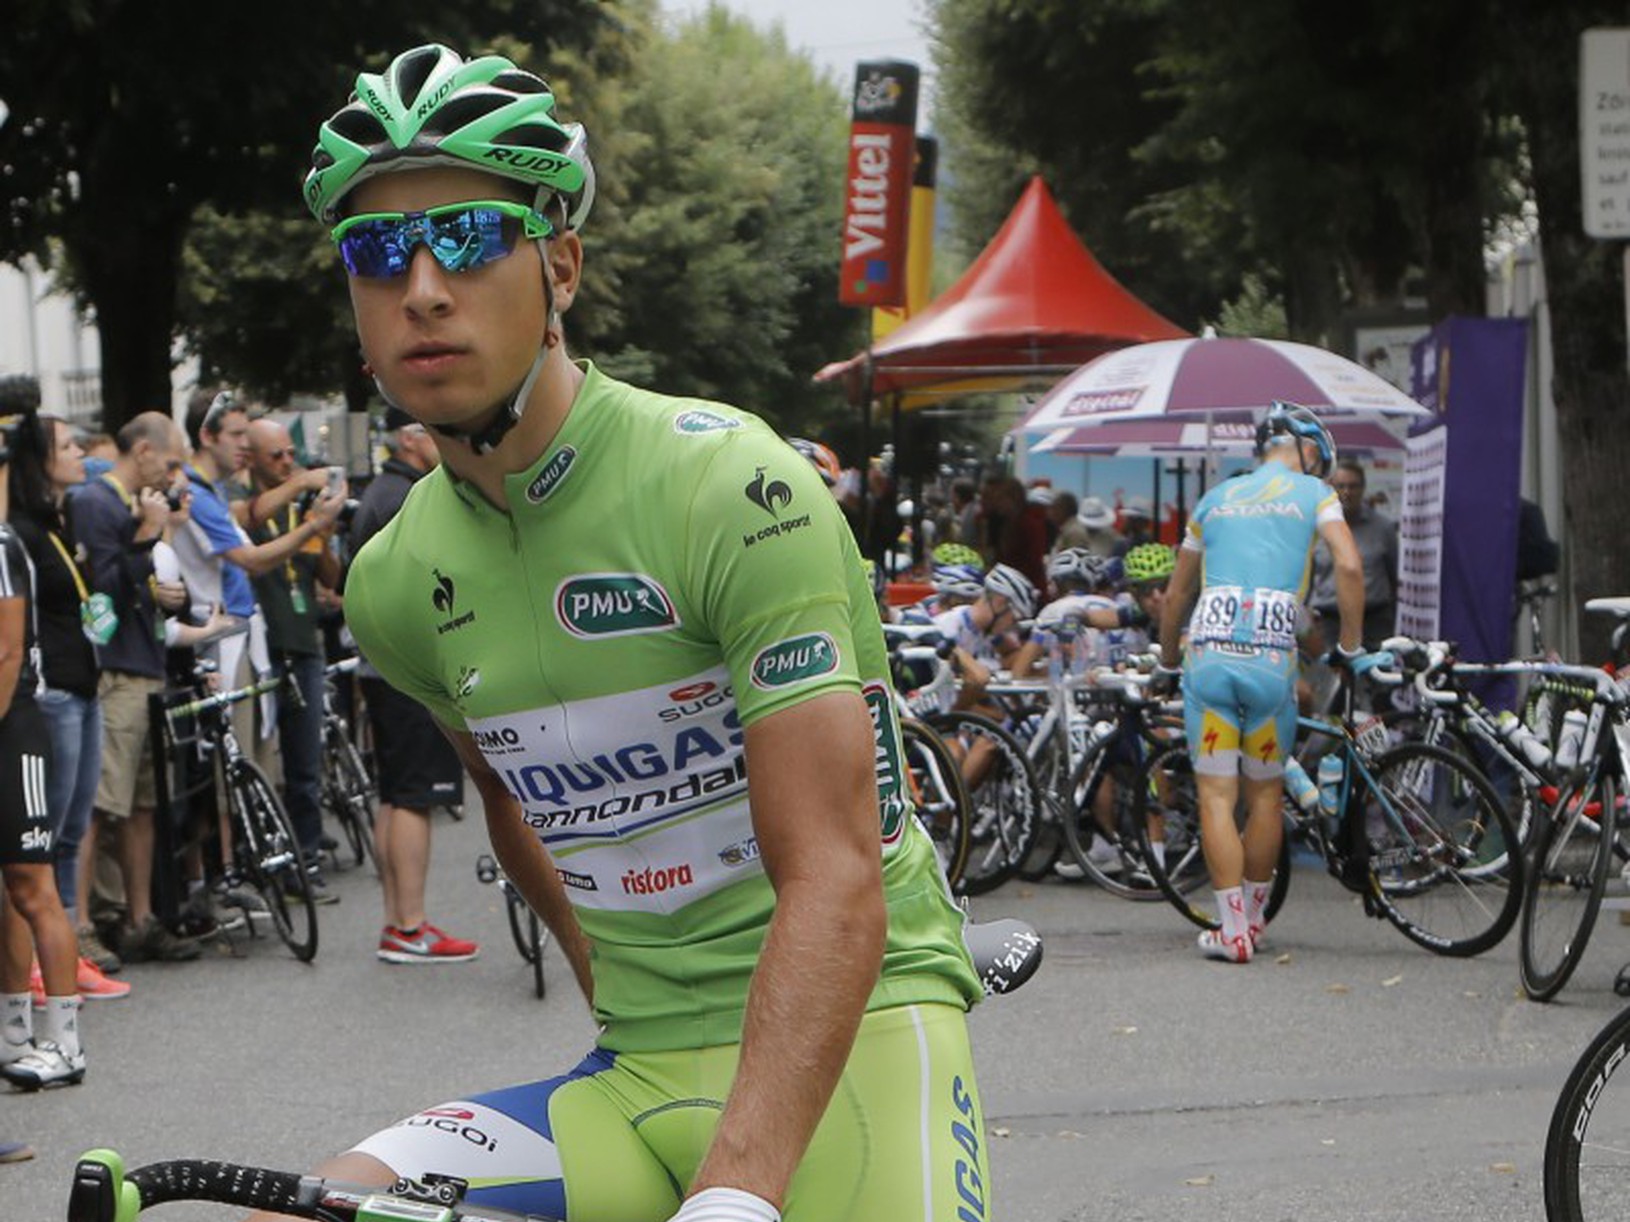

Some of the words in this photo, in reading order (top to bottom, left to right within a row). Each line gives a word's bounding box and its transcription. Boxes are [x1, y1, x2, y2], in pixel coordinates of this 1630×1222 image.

[366, 88, 395, 122] RUDY
[417, 74, 457, 120] RUDY
[482, 147, 572, 174] RUDY
[845, 132, 892, 260] Vittel
[532, 464, 561, 495] PMU
[1205, 501, 1305, 521] ASTANA
[757, 523, 781, 542] coq
[571, 591, 633, 620] PMU
[1258, 600, 1298, 635] 189
[760, 648, 813, 680] PMU
[503, 708, 744, 806] IQUIGAS
[21, 826, 53, 853] sky
[620, 863, 694, 896] ristora
[405, 1118, 499, 1153] UGOi
